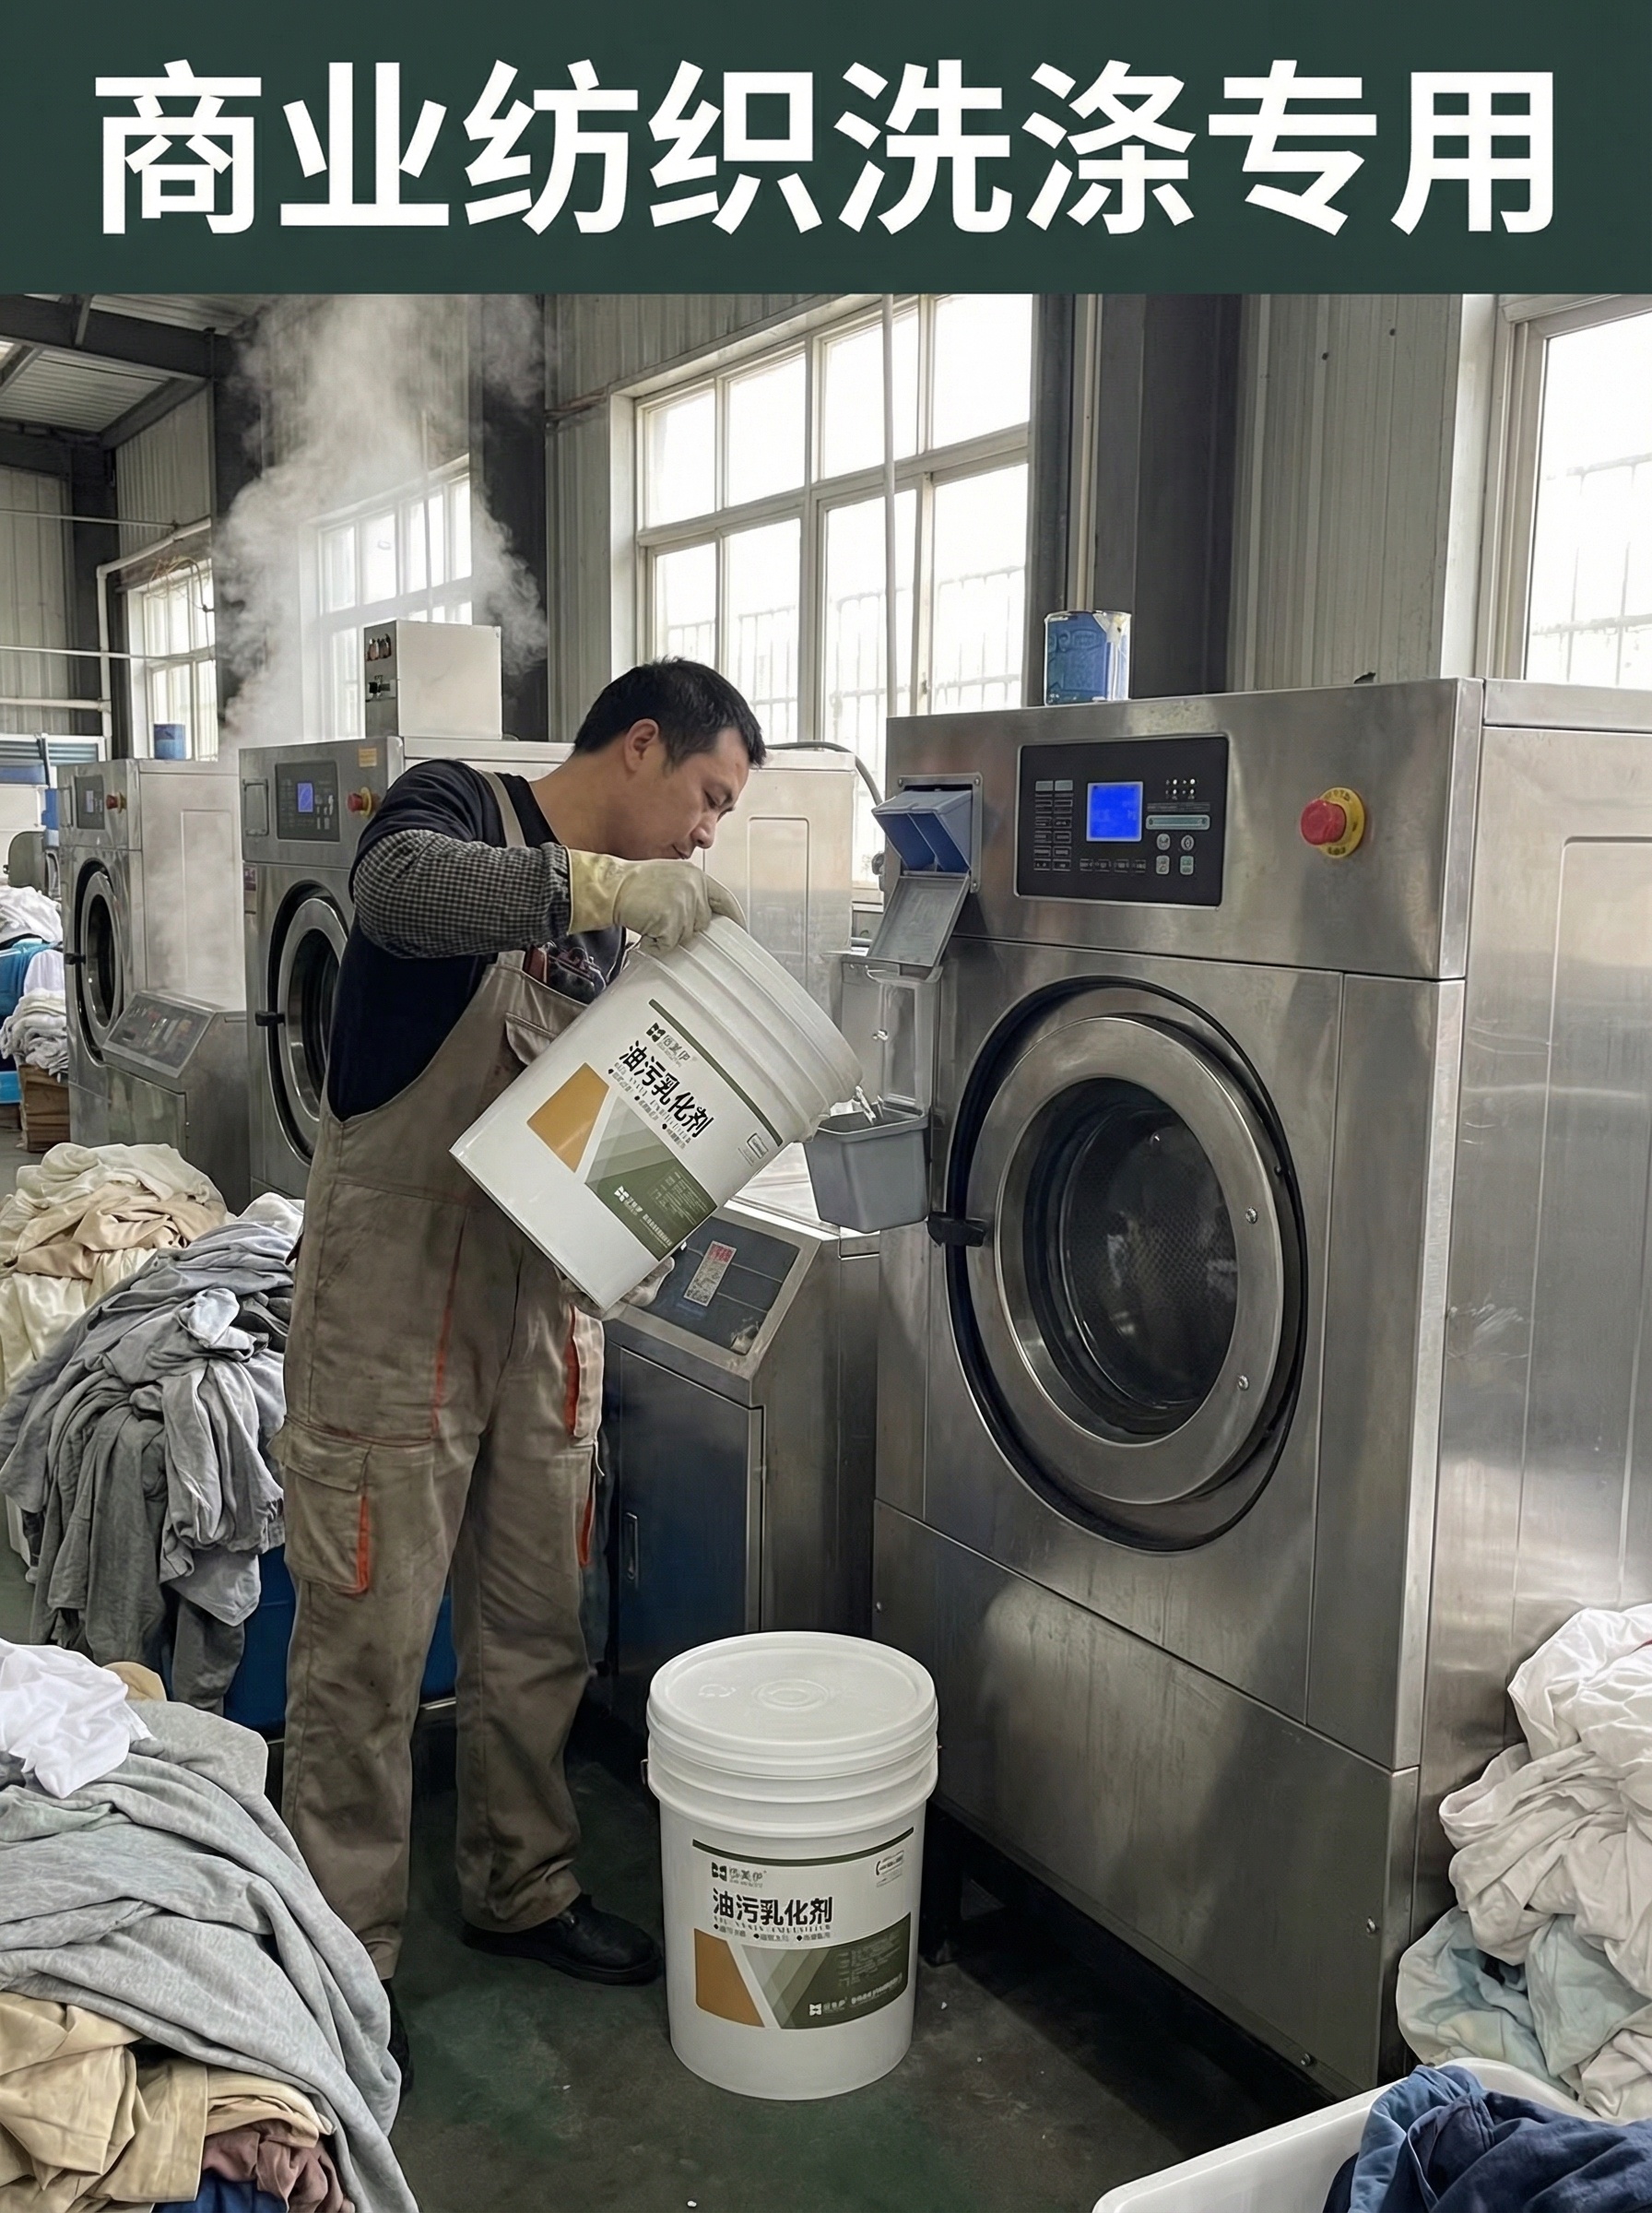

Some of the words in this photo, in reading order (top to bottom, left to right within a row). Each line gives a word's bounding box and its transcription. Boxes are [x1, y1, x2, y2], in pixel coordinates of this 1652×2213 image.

[620, 1040, 714, 1138] 油污乳化剂
[713, 1888, 832, 1926] 油污乳化剂
